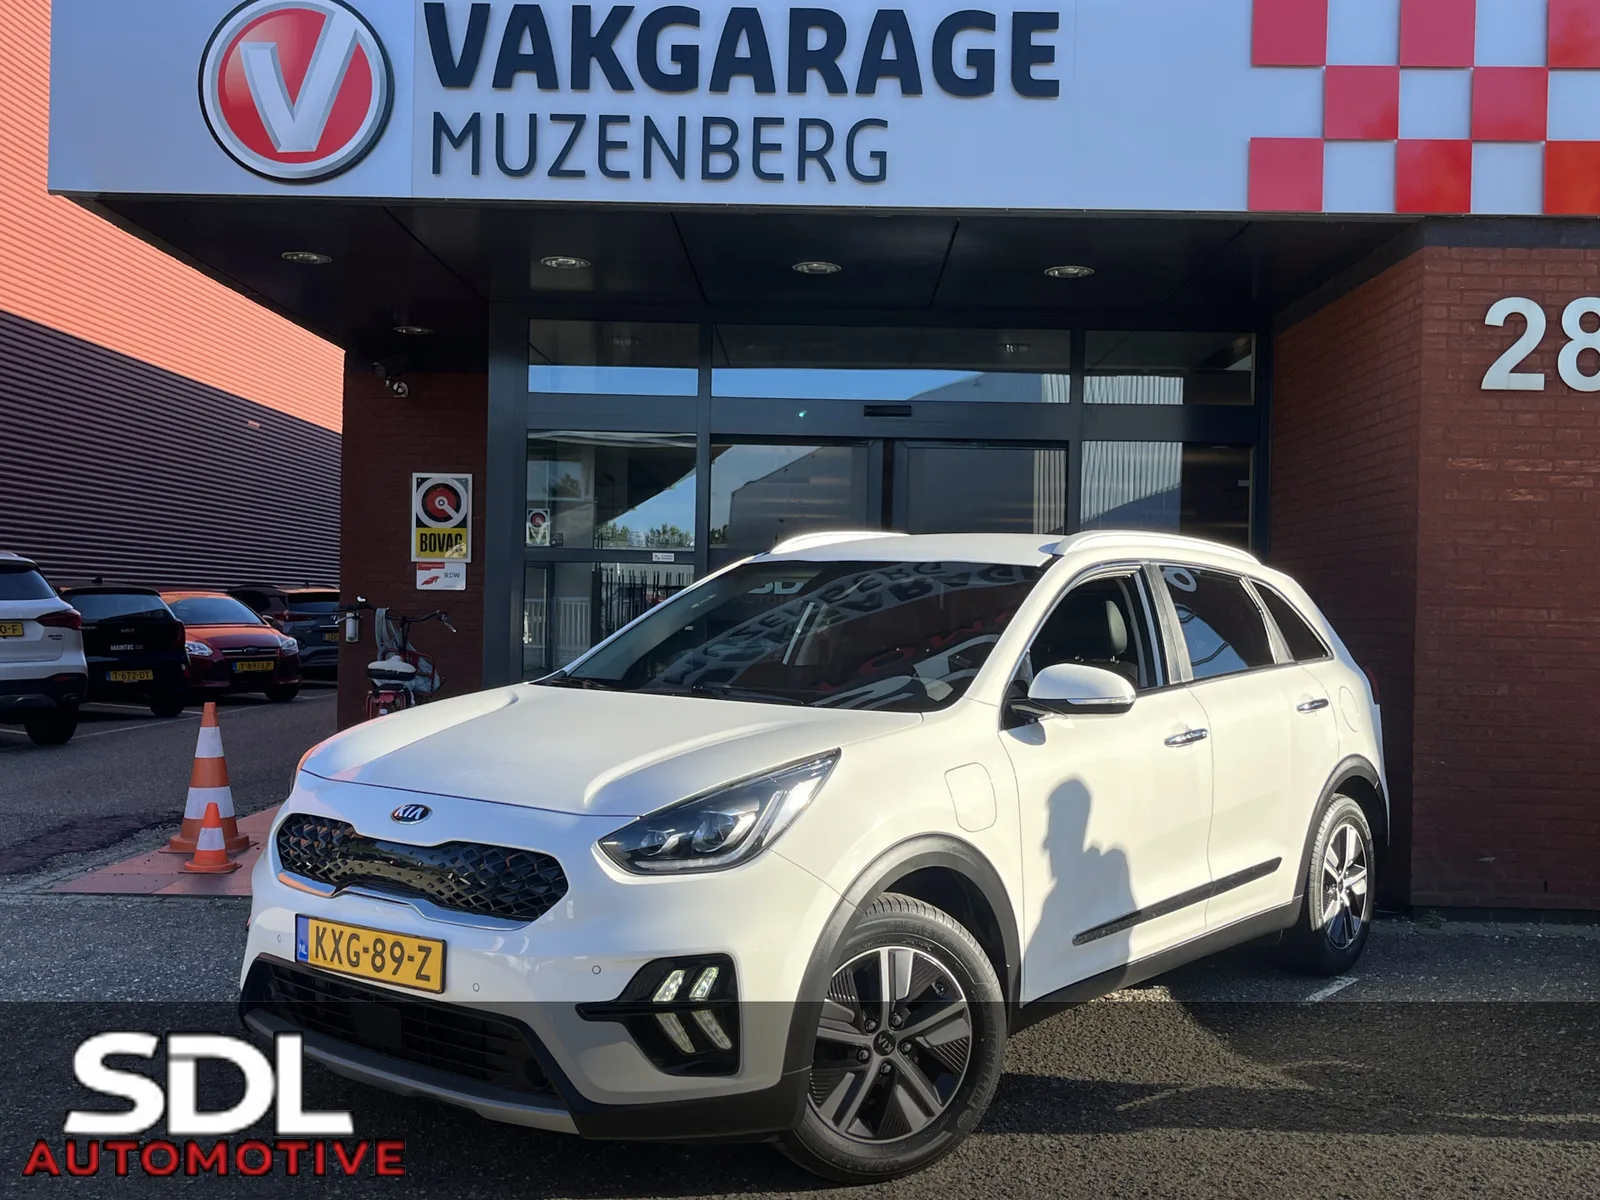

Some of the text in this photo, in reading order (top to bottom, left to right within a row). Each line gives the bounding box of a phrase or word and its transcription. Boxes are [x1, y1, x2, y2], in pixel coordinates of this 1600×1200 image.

[423, 2, 1060, 98] VAKGARAGE
[431, 111, 889, 183] MUZENBERG
[1480, 296, 1600, 393] 28
[394, 804, 425, 820] KIA
[298, 943, 308, 955] NL
[314, 924, 433, 982] KXG-89-Z
